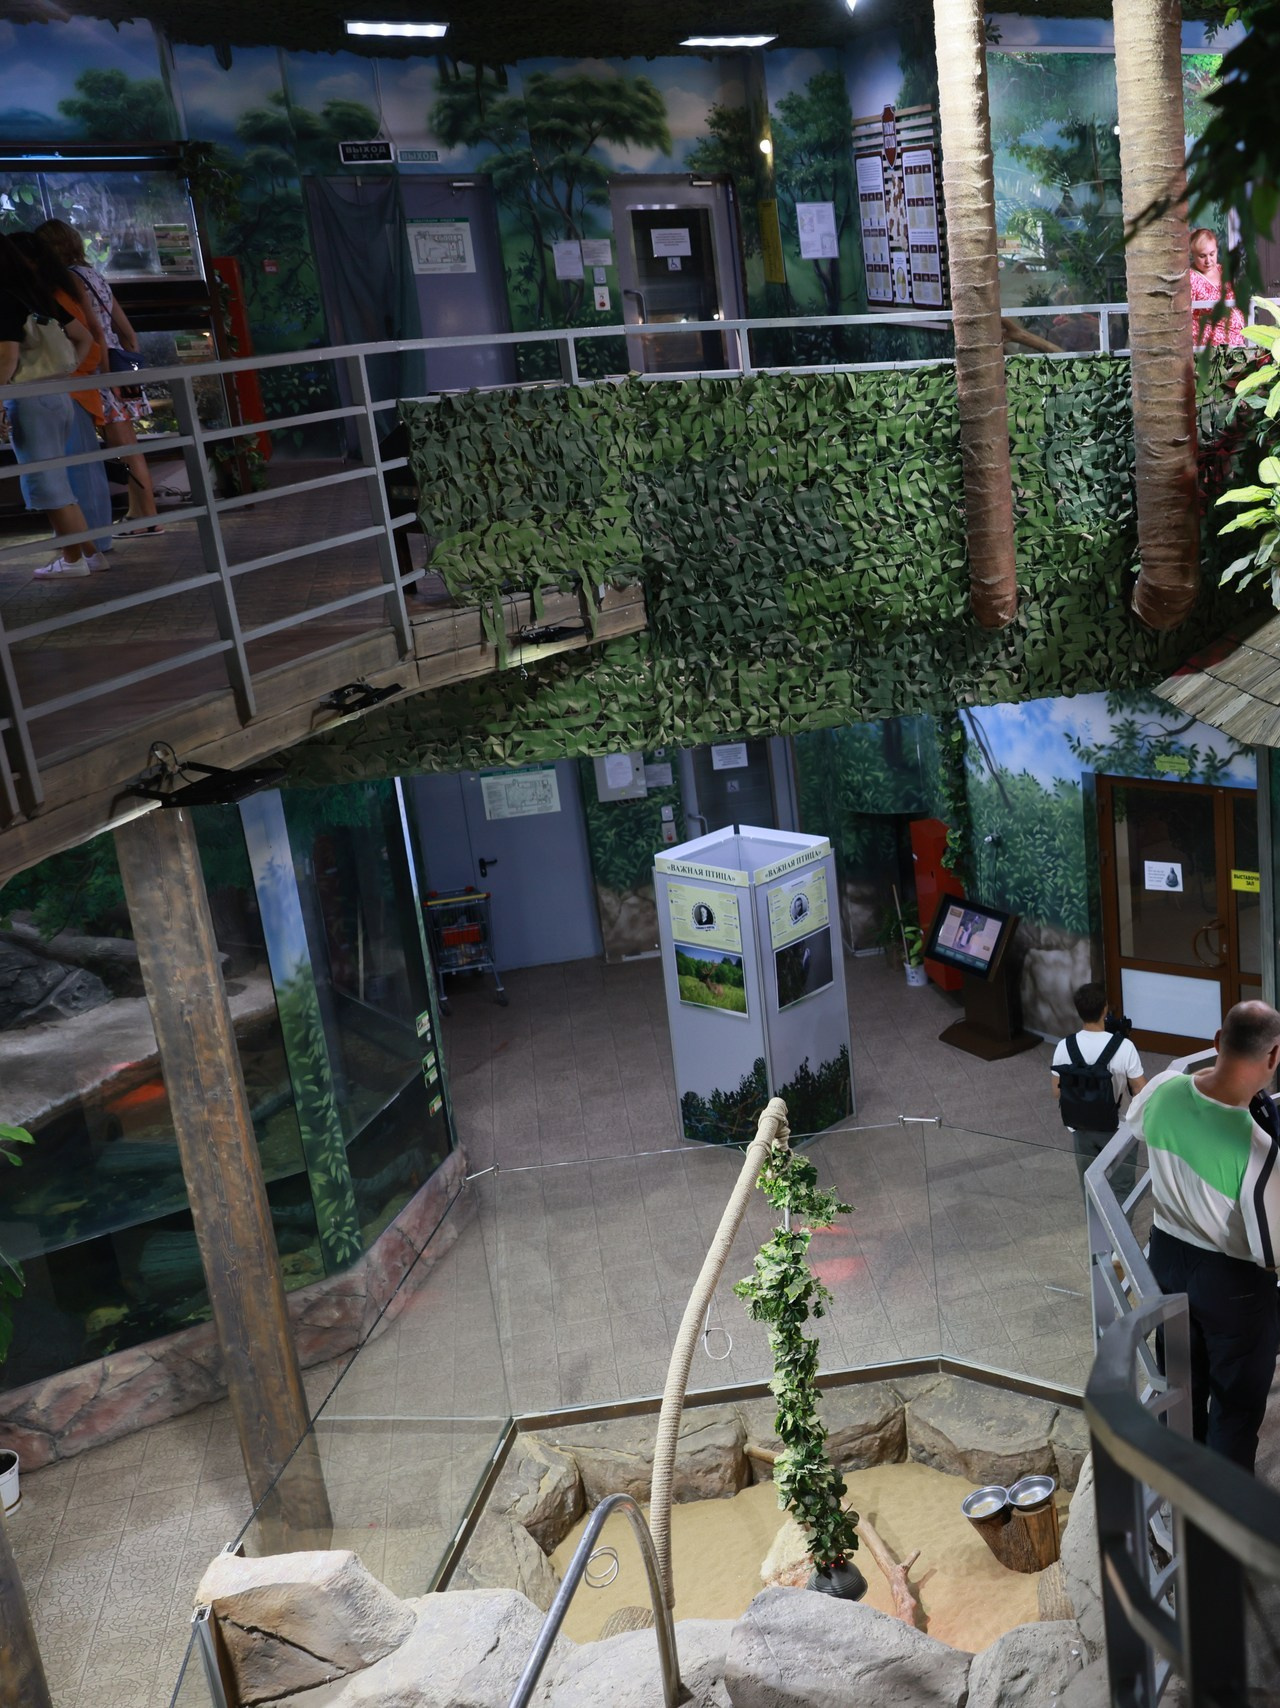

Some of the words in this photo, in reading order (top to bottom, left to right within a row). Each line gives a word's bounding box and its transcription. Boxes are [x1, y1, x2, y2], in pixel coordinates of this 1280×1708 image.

[345, 145, 387, 154] ВЫХОД
[401, 152, 437, 161] ВЫХОД
[765, 860, 795, 878] «ВАЖНАЯ
[796, 850, 822, 865] ПТИЦА»
[667, 864, 703, 876] «ВАЖНАЯ
[705, 869, 736, 881] ПТИЦА»
